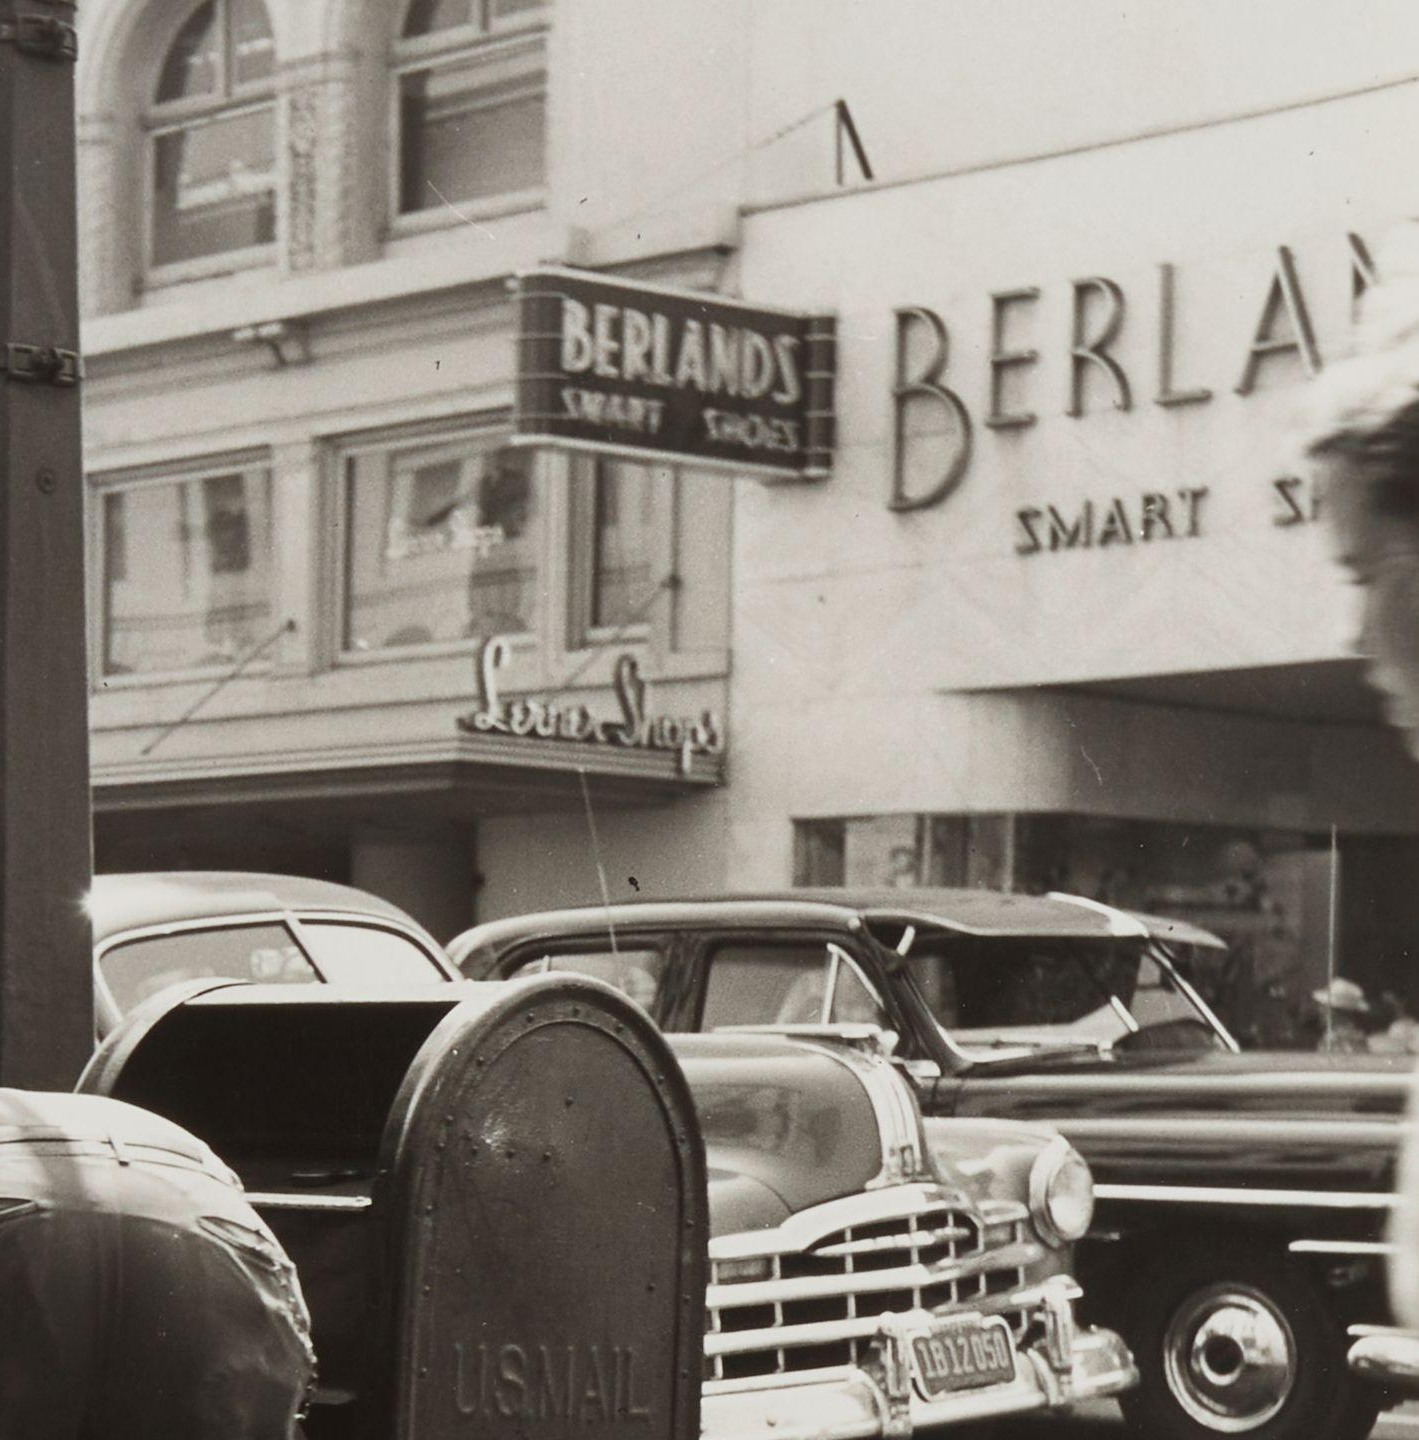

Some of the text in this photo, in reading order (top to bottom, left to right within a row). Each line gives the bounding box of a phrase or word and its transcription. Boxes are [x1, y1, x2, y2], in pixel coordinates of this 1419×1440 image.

[561, 298, 801, 405] BERLANDS
[561, 386, 800, 452] SMART SHOES
[1014, 486, 1210, 556] SMART
